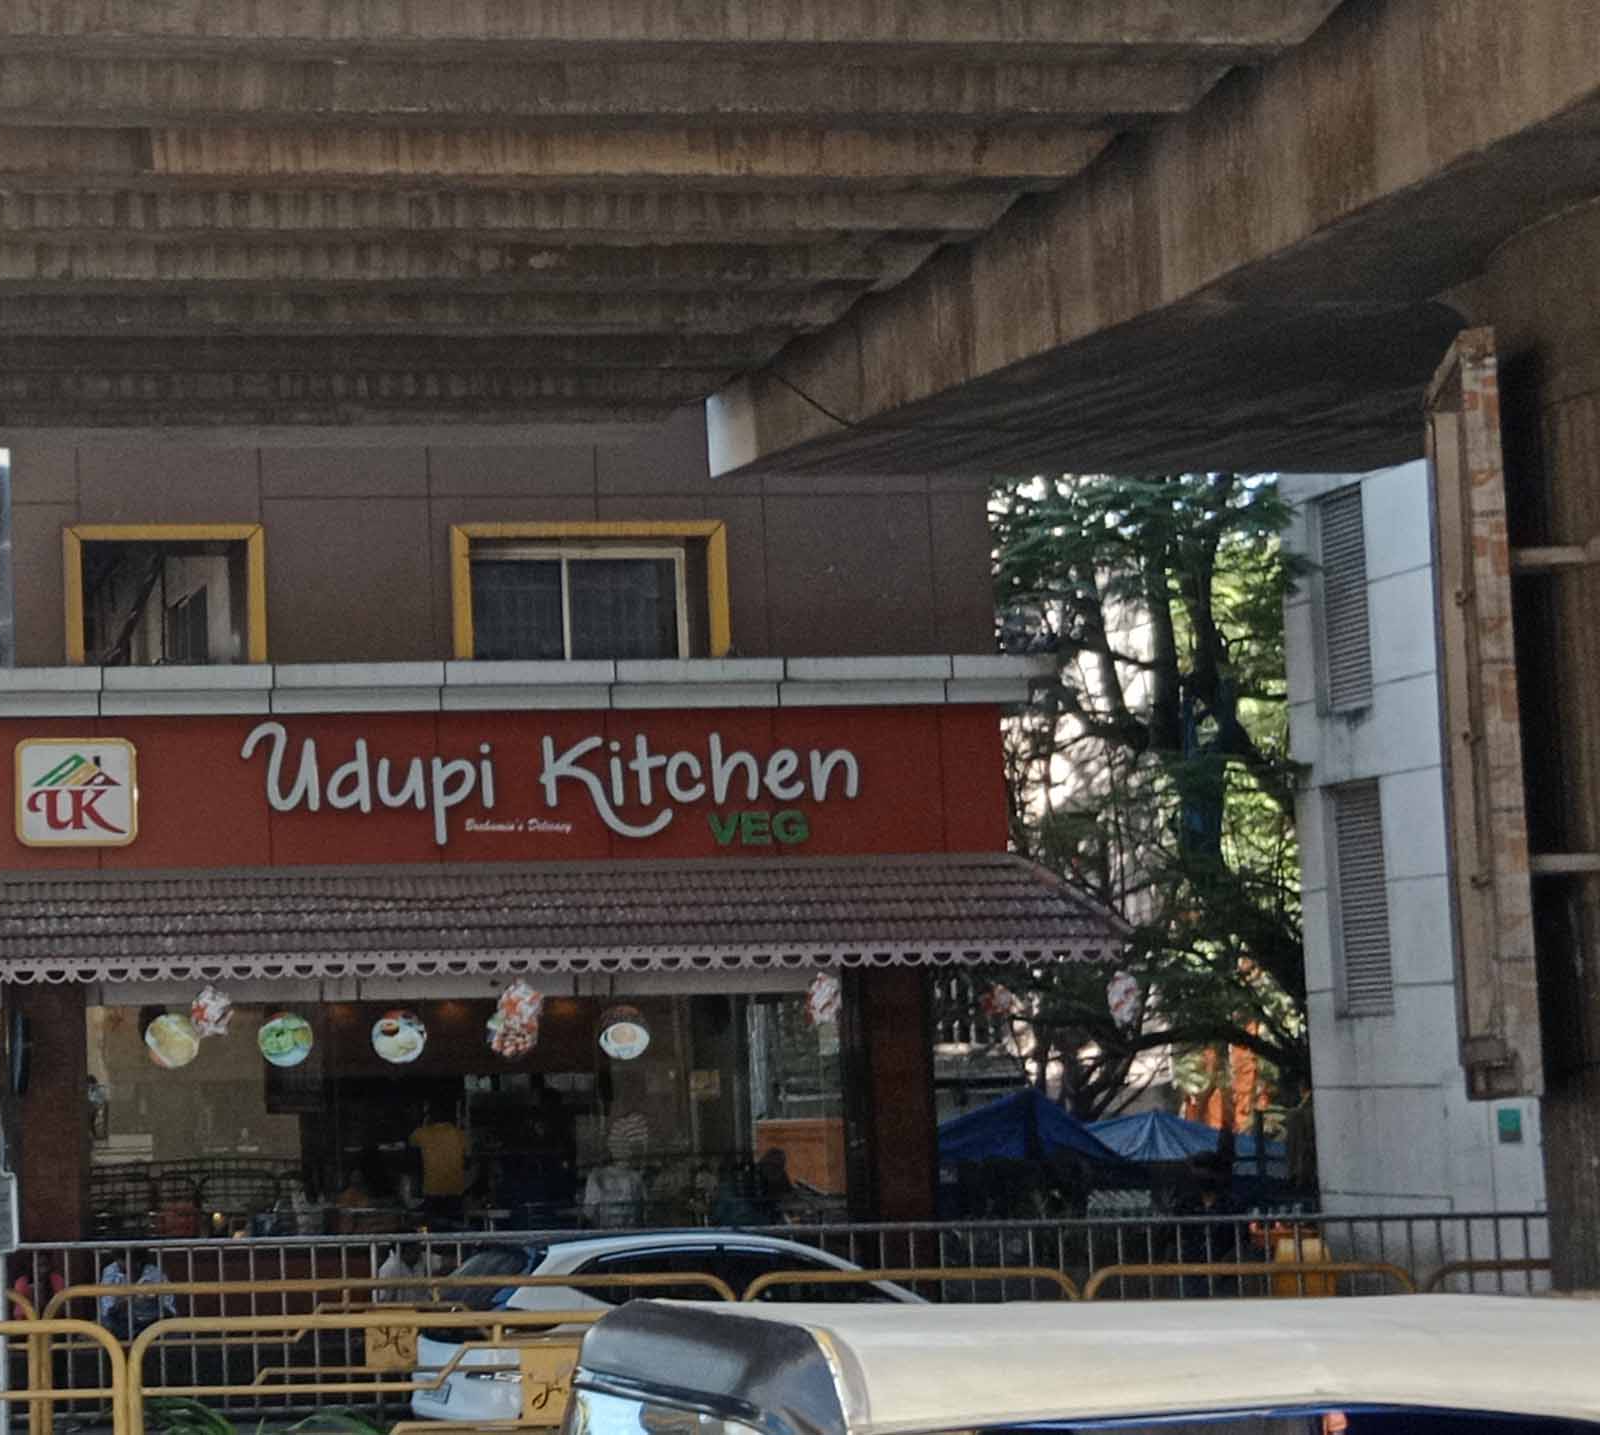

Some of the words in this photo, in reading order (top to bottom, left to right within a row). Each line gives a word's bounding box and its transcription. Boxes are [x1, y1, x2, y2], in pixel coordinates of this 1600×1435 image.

[241, 722, 493, 844] Udupi
[541, 733, 859, 838] Kitchen
[27, 788, 127, 834] UK
[708, 811, 810, 845] VEG
